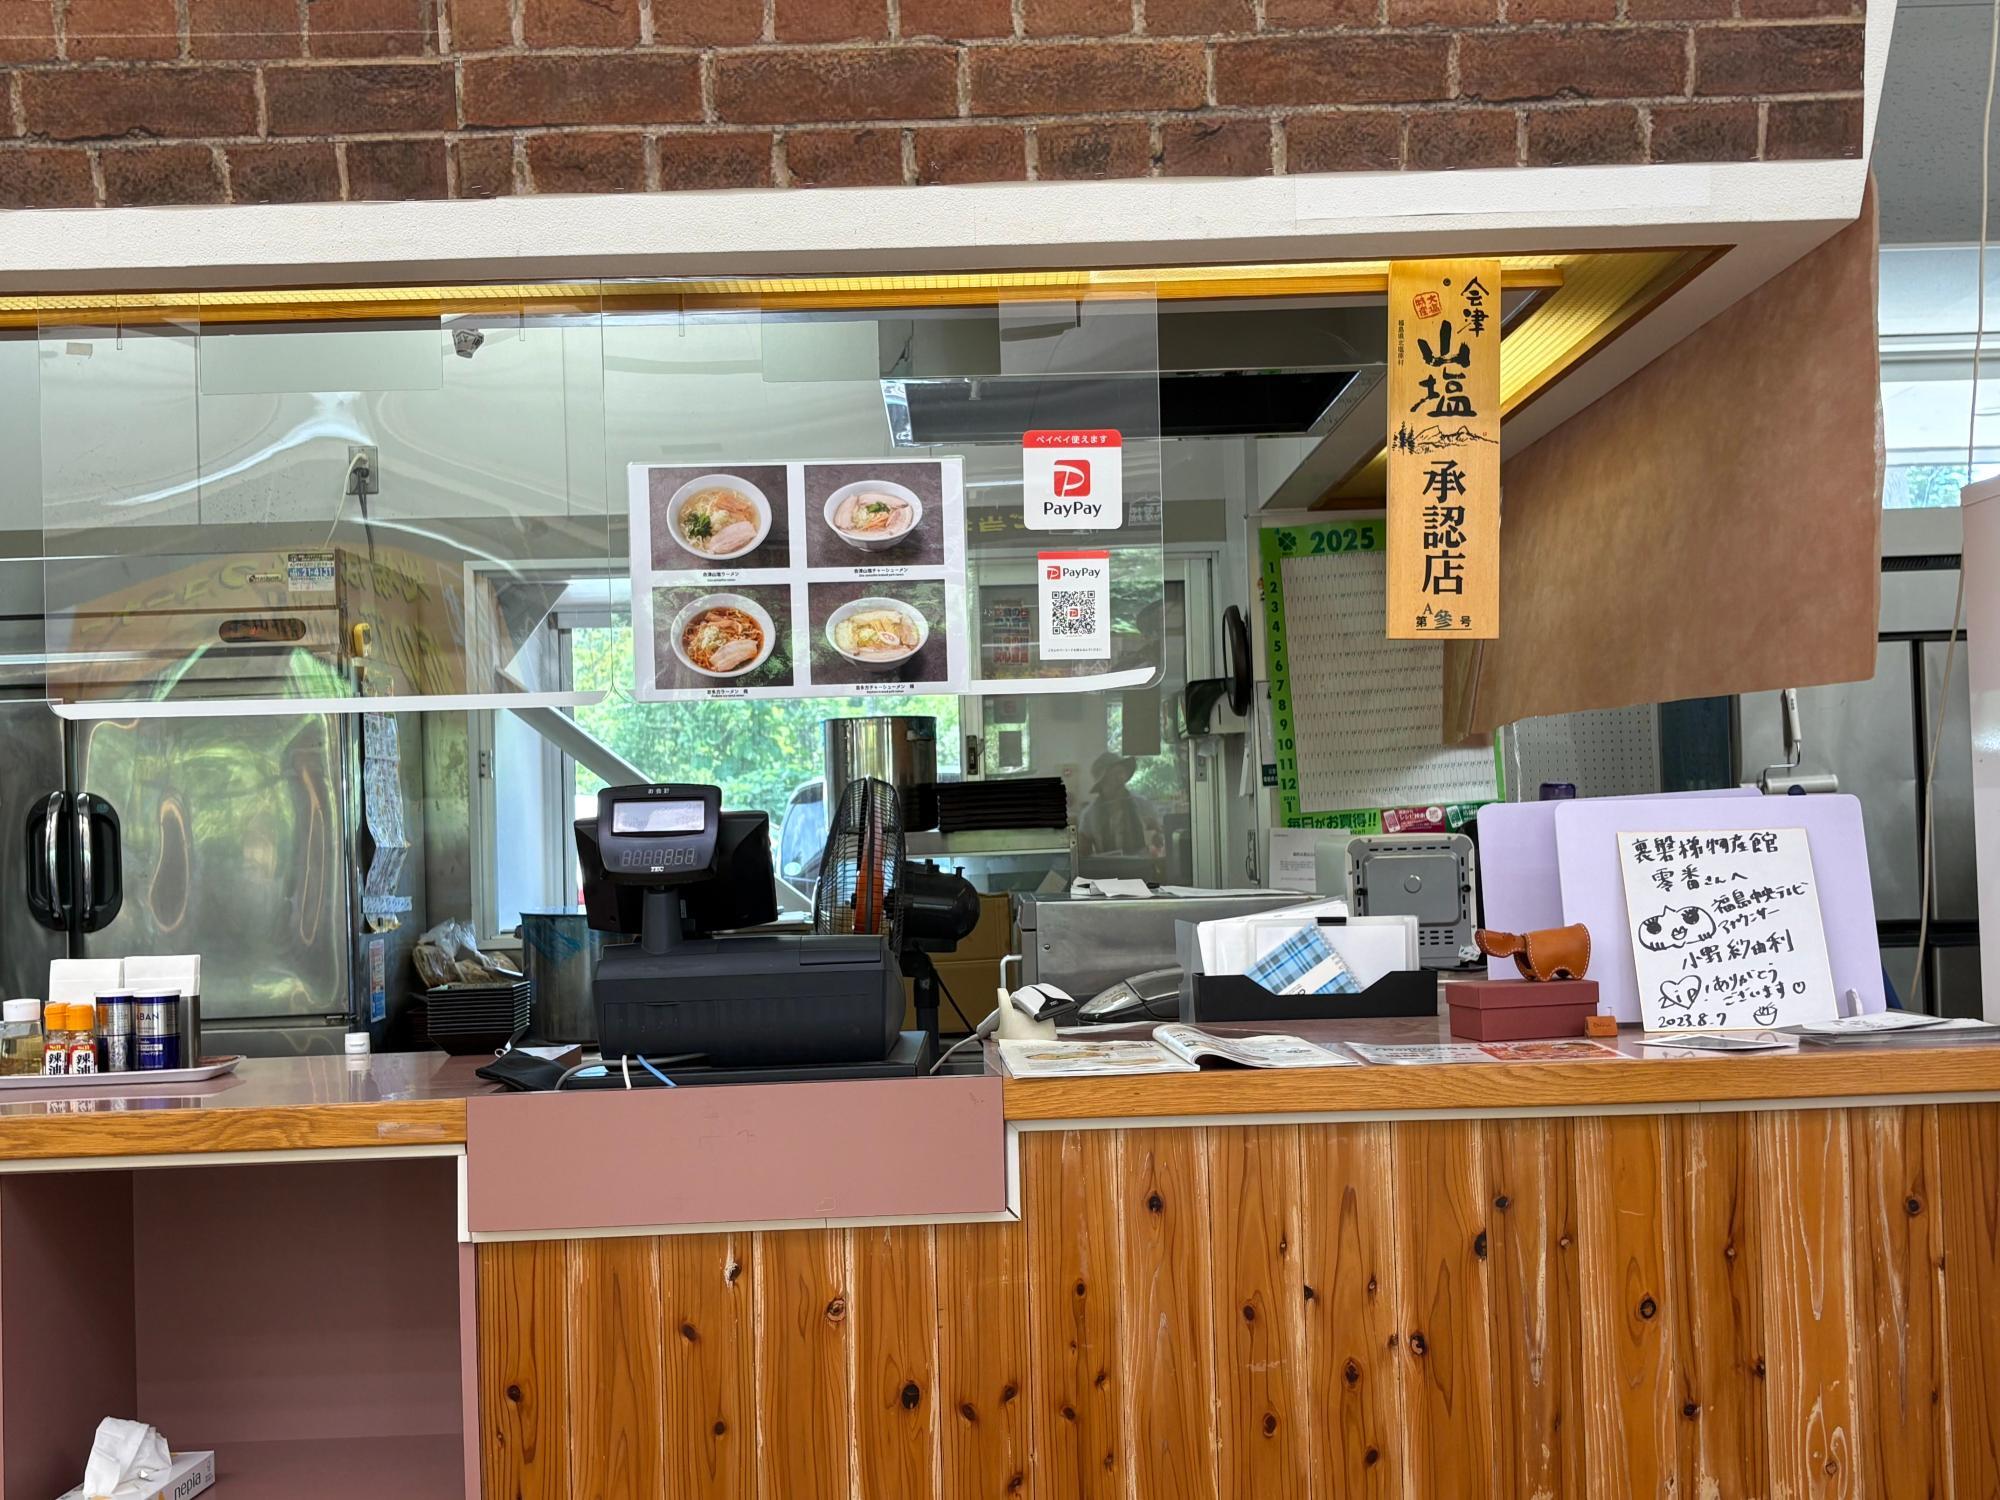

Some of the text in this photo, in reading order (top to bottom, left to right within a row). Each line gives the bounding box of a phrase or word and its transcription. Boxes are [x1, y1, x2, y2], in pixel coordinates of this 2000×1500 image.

[1457, 276, 1490, 338] 会津
[1410, 320, 1478, 418] 山塩
[1036, 435, 1109, 445] ペイペイ使えます
[1043, 501, 1103, 518] PayPay
[1421, 459, 1468, 596] 承認店
[1310, 527, 1375, 554] 2025
[1062, 567, 1101, 580] PayPay
[1268, 562, 1275, 574] 1
[1270, 581, 1278, 594] 2
[1271, 601, 1279, 614] 3
[1423, 602, 1434, 615] A
[1272, 620, 1280, 633] 4
[1274, 640, 1282, 653] 5
[1275, 659, 1283, 672] 6
[1276, 679, 1285, 692] 7
[1278, 698, 1286, 711] 8
[1280, 718, 1288, 731] 9
[1278, 738, 1294, 751] 10
[1279, 758, 1294, 771] 11
[1281, 777, 1297, 791] 12
[1287, 800, 1293, 813] 1
[1632, 831, 1779, 864] 裏磐梯物産館
[1651, 864, 1749, 893] 零番さんへ
[1711, 882, 1809, 914] 福島中央テレビ
[1713, 962, 1778, 992] ありがとう
[1723, 981, 1786, 1007] ございます
[174, 1472, 201, 1500] nepia
